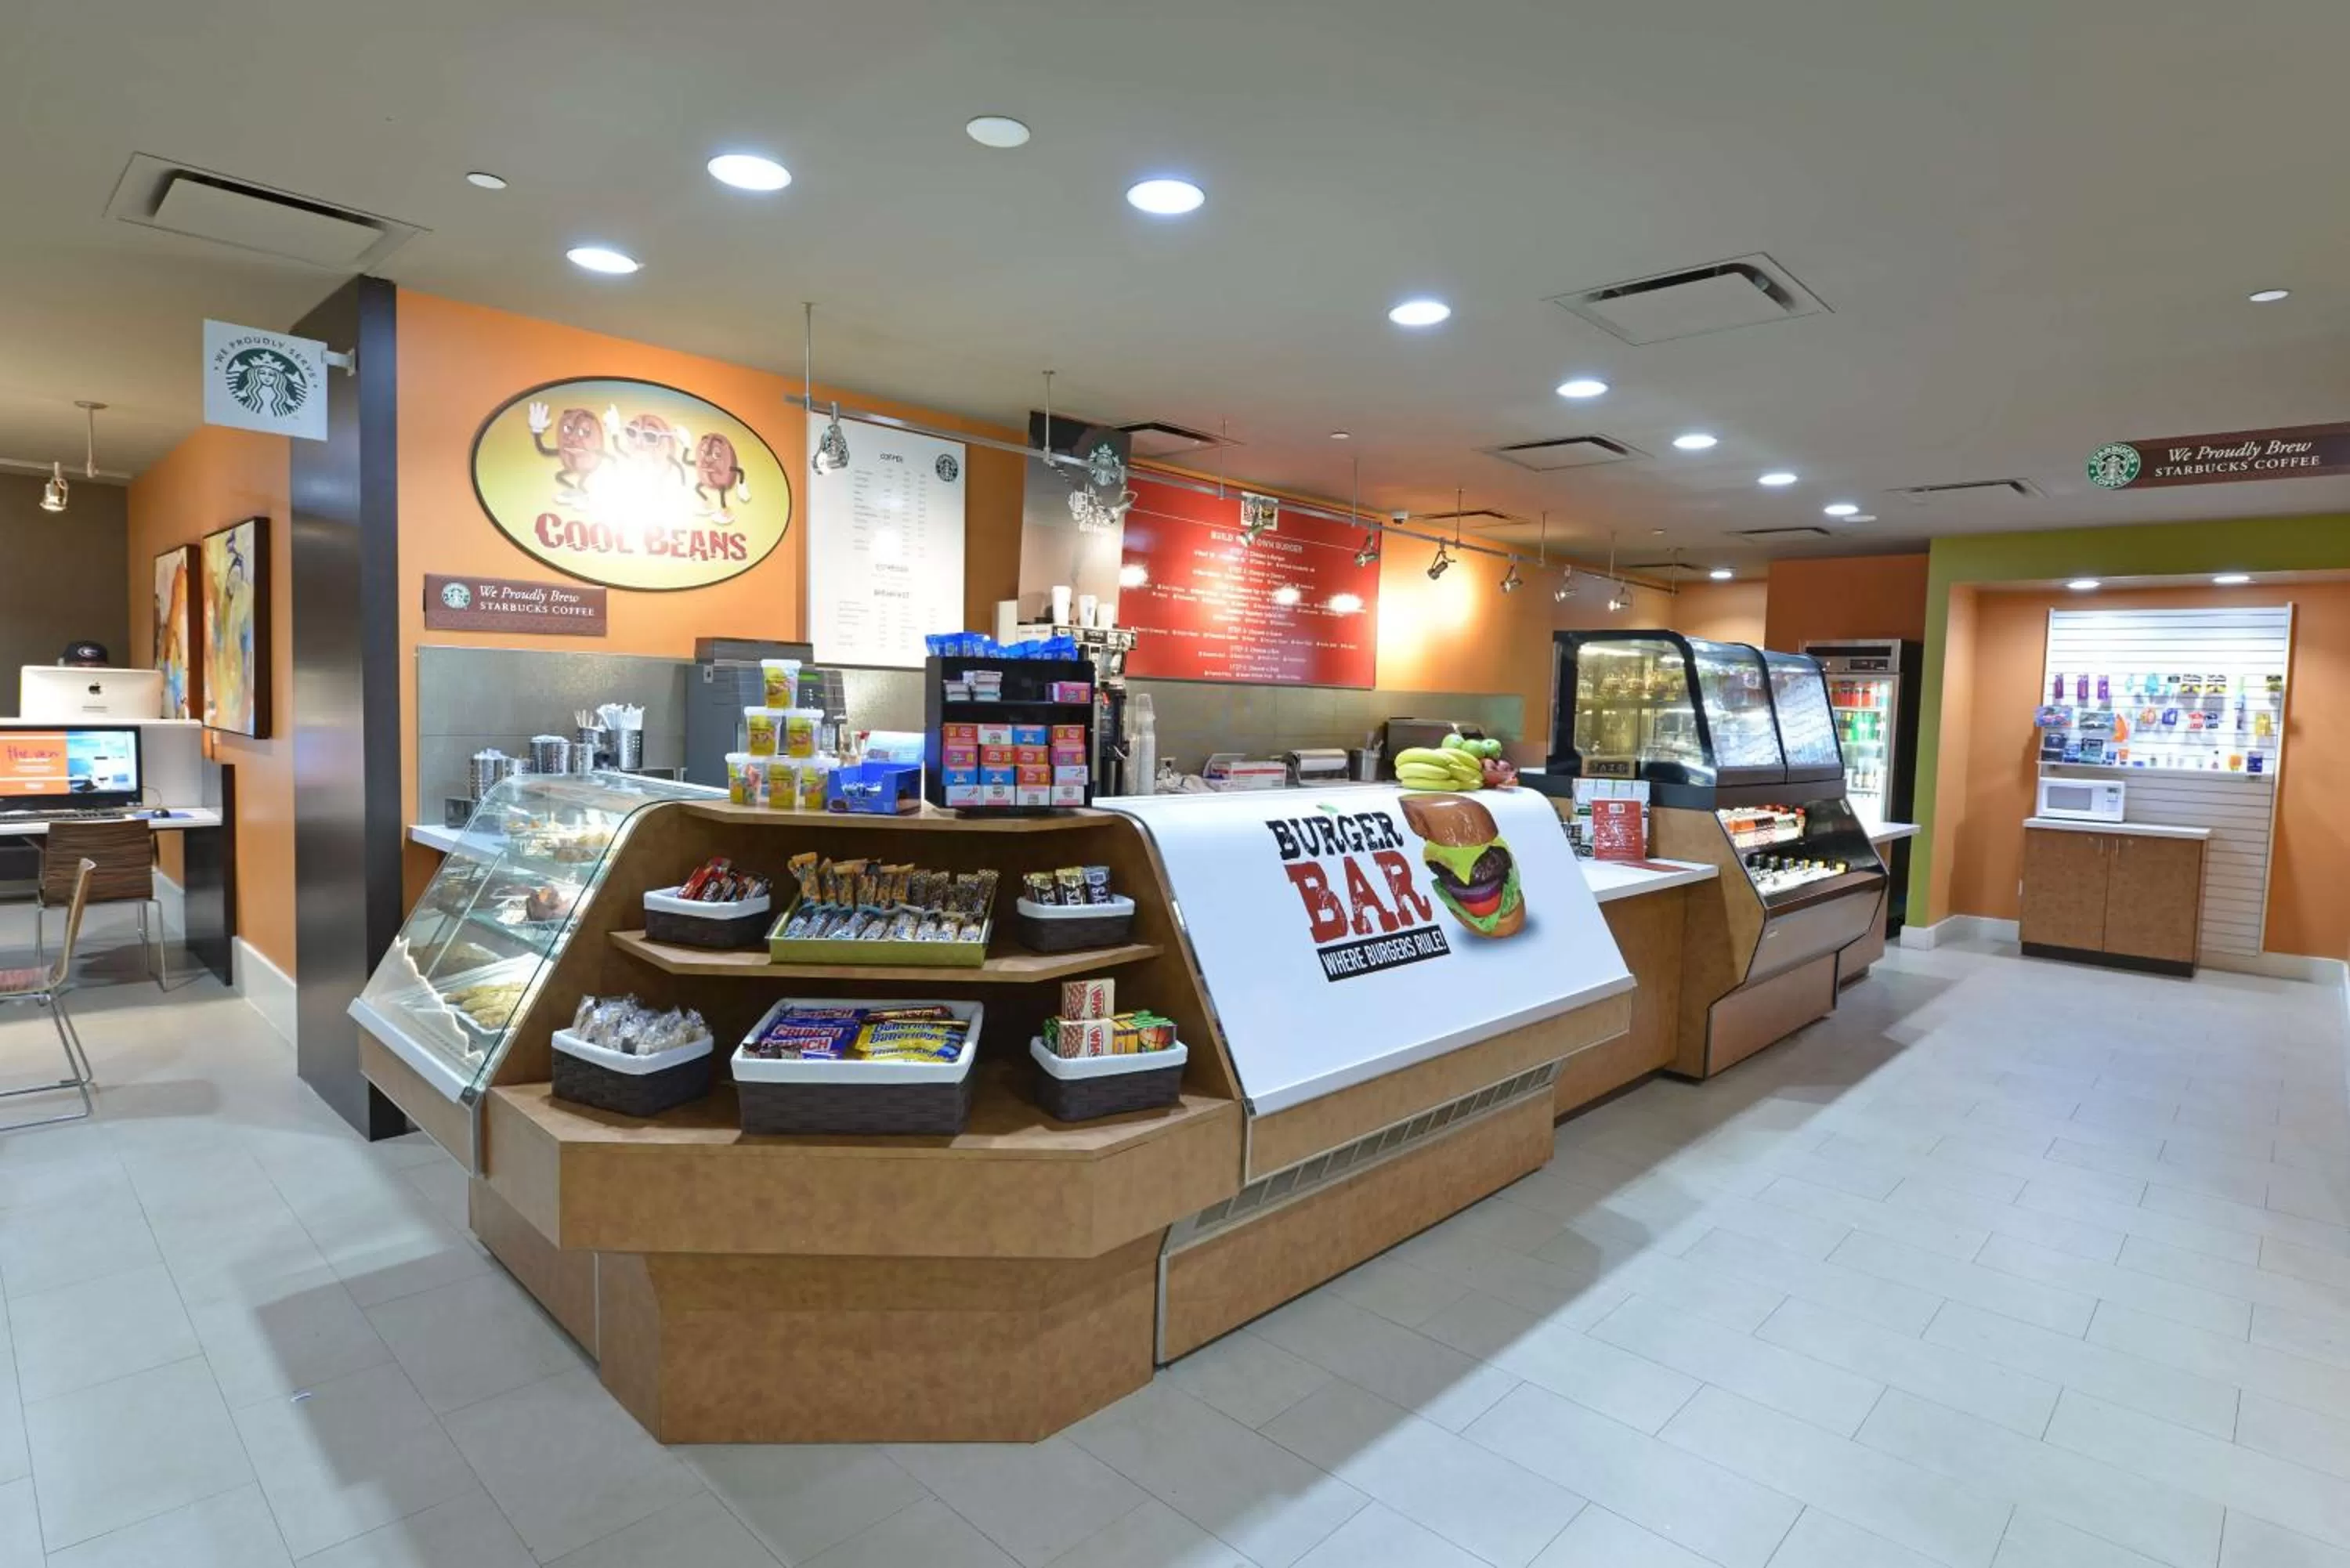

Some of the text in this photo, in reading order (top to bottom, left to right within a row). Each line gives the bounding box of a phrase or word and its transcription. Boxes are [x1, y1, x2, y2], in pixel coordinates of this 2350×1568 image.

[215, 336, 317, 378] WE PROUDLY SERVE
[2167, 439, 2312, 461] We Proudly Brew
[2155, 455, 2320, 477] STARBUCKS COFFEE
[643, 522, 748, 562] BEANS
[479, 585, 580, 604] We Proudly Brew
[479, 601, 595, 617] STARBUCKS COFFEE
[1266, 811, 1404, 860] BURGER
[1285, 851, 1433, 944] BAR
[1321, 930, 1448, 975] WHERE BURGERS RULE!
[774, 1025, 841, 1040] CRUNCH
